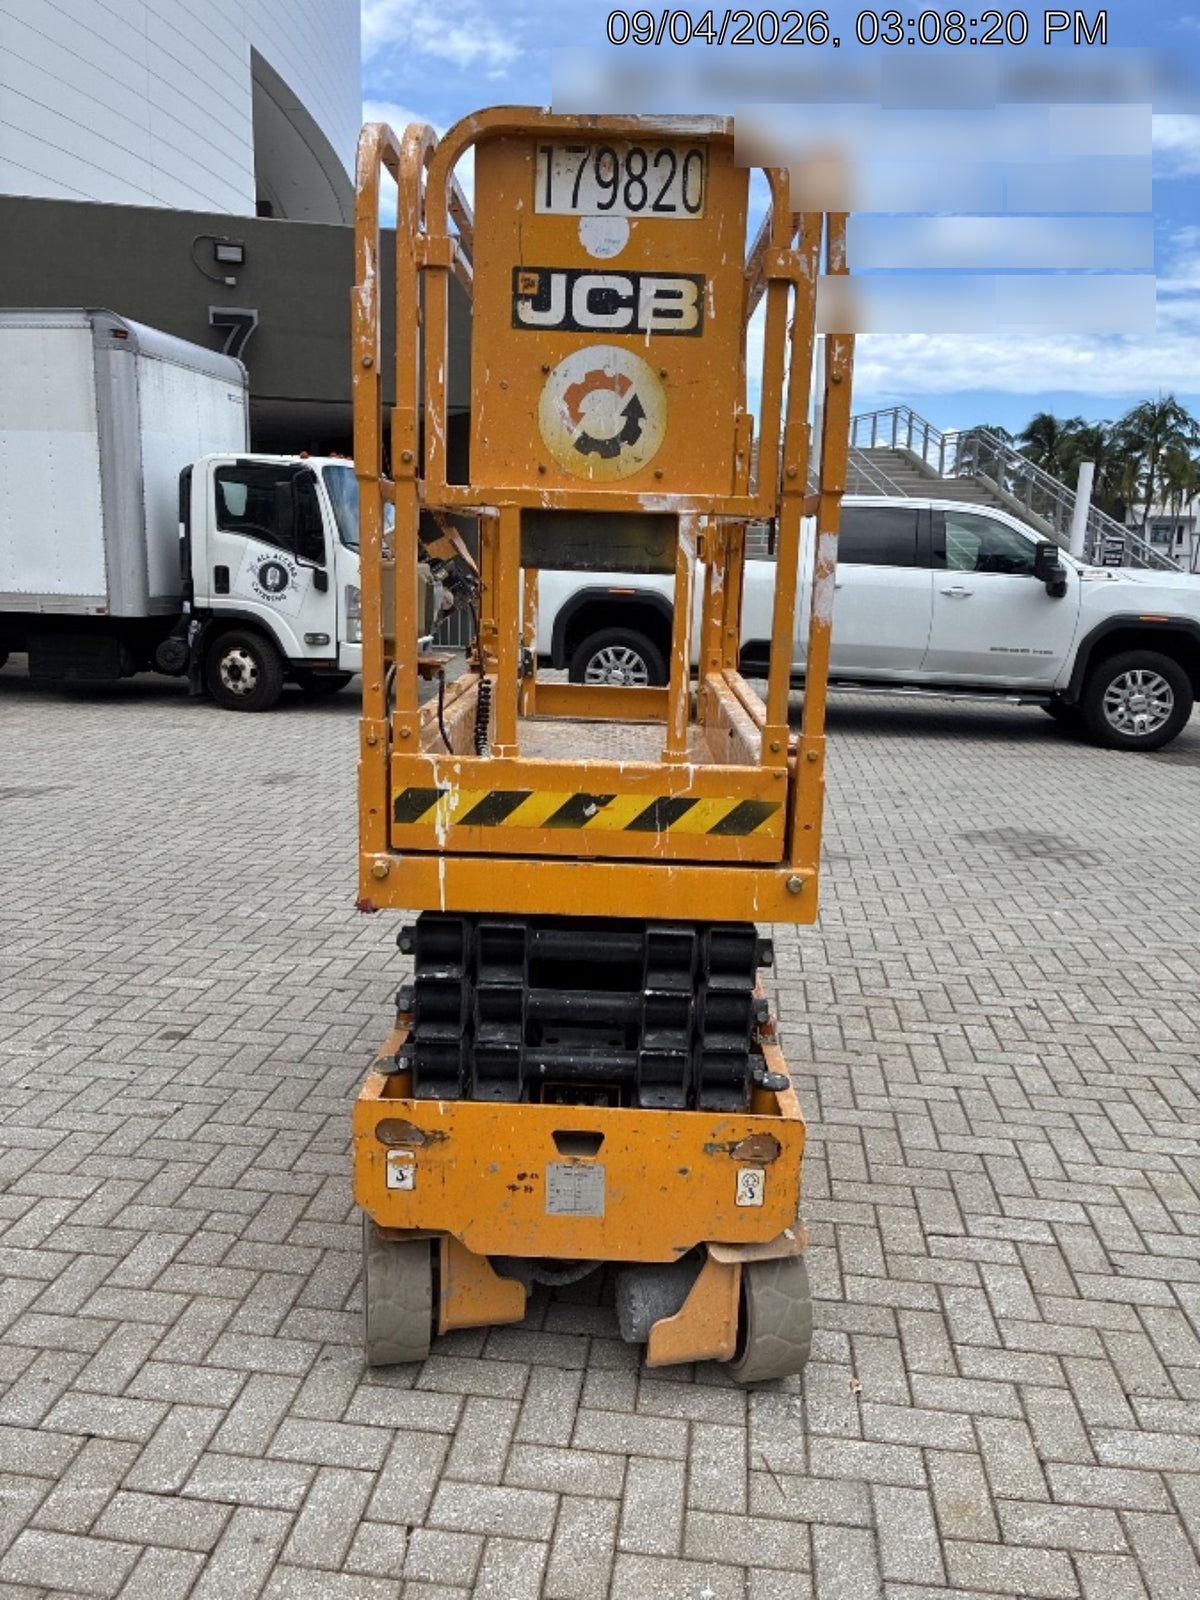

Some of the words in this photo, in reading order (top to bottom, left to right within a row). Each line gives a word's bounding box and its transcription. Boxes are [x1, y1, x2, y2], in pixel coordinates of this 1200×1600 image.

[539, 144, 704, 214] 179820
[517, 273, 700, 330] JCB
[208, 306, 259, 358] 7
